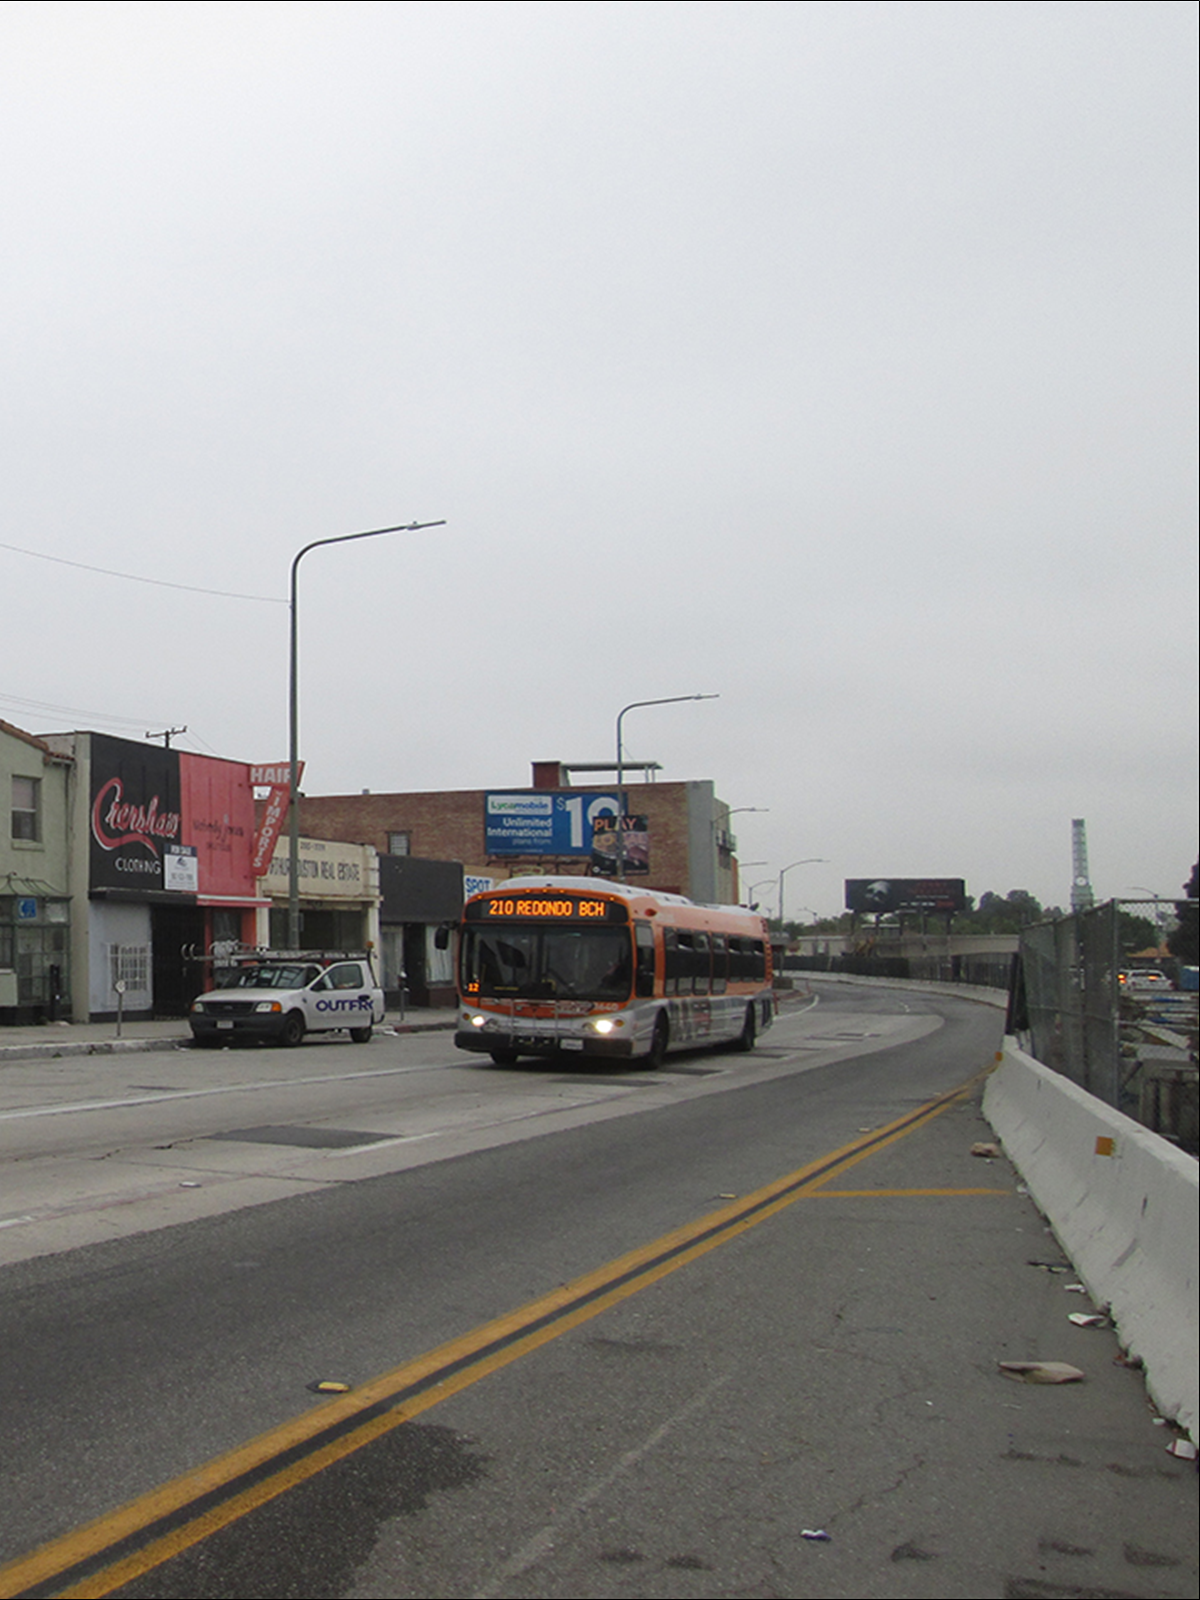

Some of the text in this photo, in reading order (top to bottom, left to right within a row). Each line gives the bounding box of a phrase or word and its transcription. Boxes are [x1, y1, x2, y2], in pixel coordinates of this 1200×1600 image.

[503, 818, 553, 828] Unlimited
[253, 796, 282, 868] IMPORTS
[487, 828, 553, 838] International
[115, 857, 161, 874] CLOTHING
[465, 877, 491, 893] SPOT
[489, 900, 605, 916] 210 REDONDO BCH
